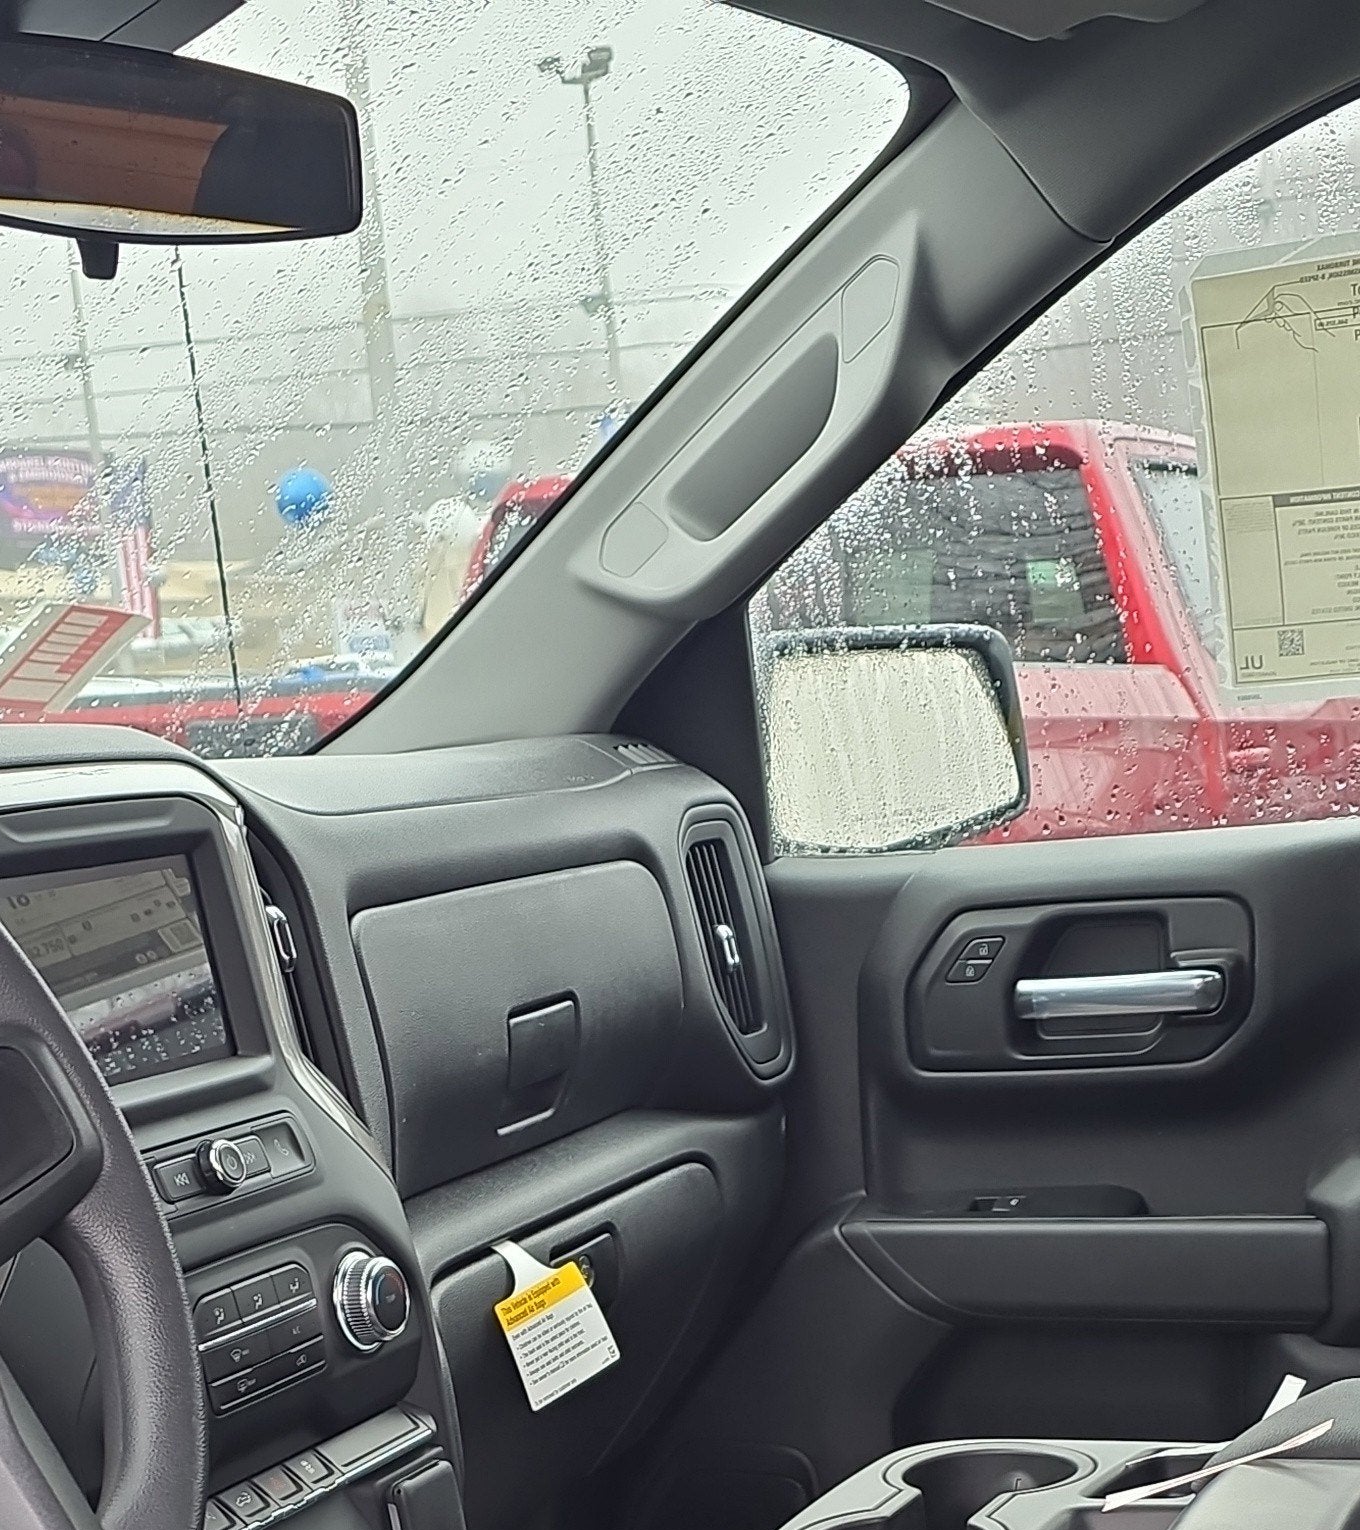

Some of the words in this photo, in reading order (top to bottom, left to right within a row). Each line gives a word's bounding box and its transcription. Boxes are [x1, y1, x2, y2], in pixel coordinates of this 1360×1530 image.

[501, 1305, 512, 1315] This
[511, 1296, 528, 1309] Vehicle
[531, 1283, 552, 1298] Equipped
[550, 1277, 560, 1286] with
[505, 1309, 528, 1325] Advanced
[534, 1298, 547, 1309] Bags
